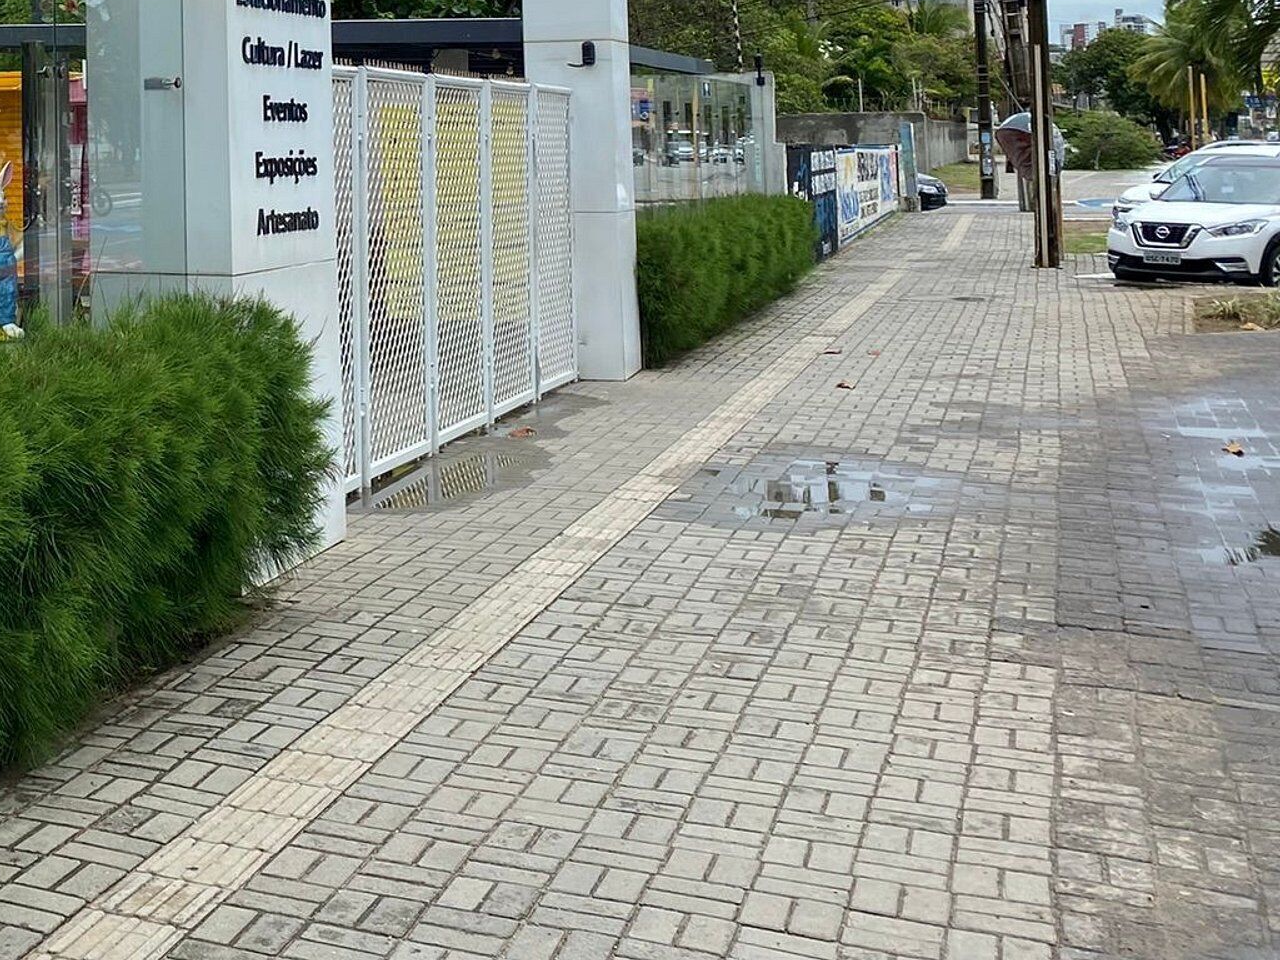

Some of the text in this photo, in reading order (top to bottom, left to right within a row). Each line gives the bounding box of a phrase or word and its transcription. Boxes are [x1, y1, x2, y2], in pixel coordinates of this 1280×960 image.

[242, 36, 285, 67] Cultura
[294, 43, 323, 70] Lazer
[263, 95, 308, 123] Eventos
[255, 150, 318, 185] Exposições
[257, 207, 319, 236] Artesanato
